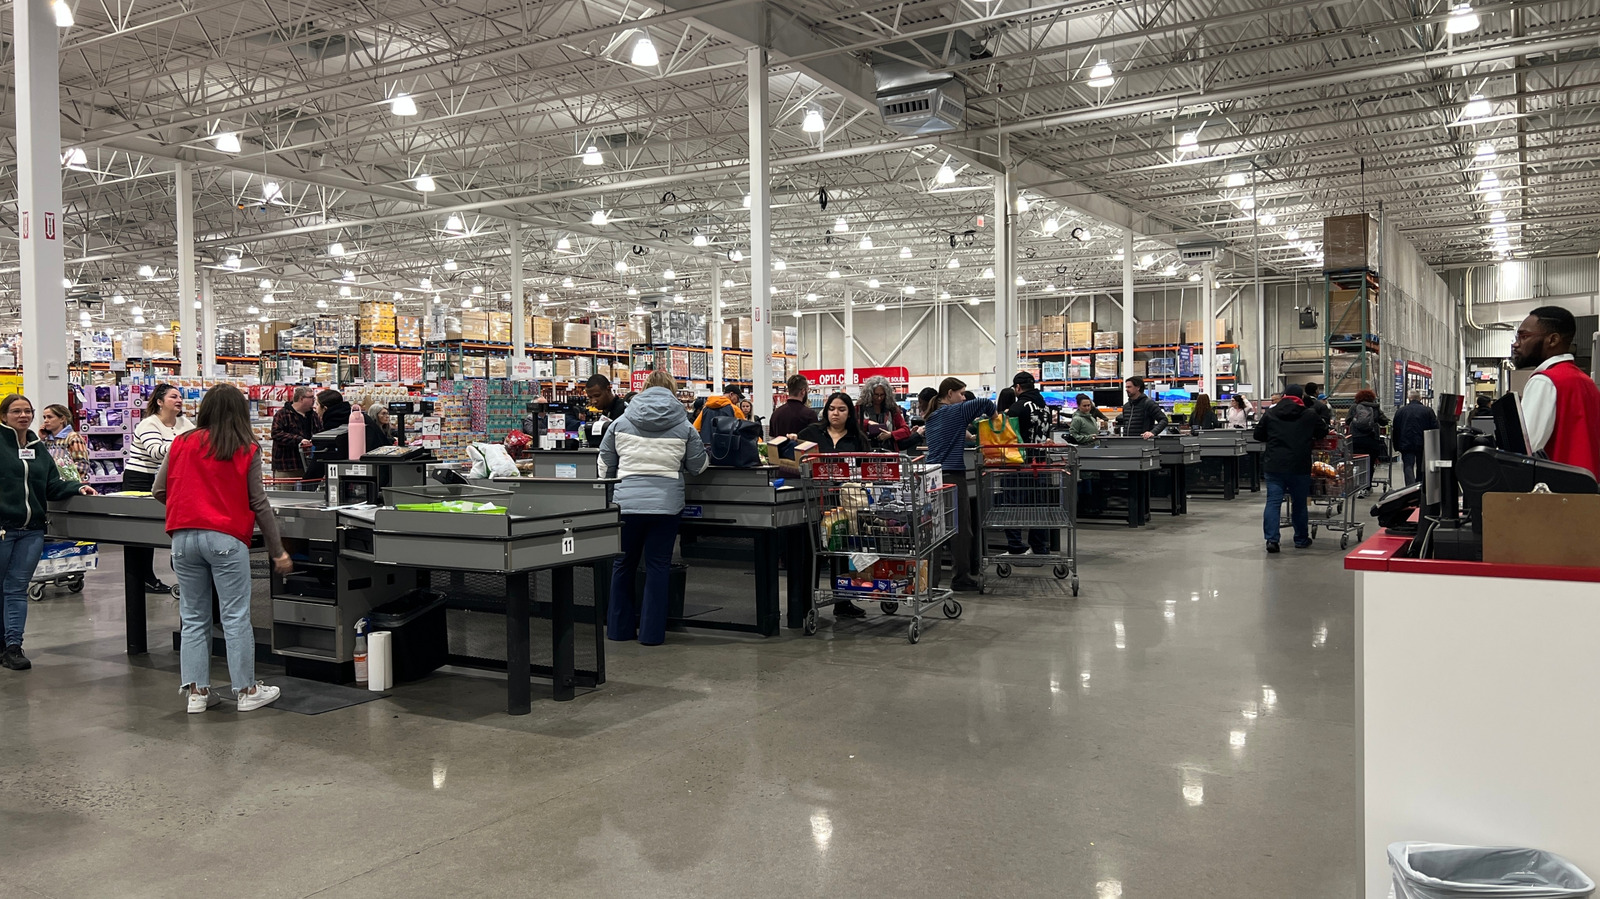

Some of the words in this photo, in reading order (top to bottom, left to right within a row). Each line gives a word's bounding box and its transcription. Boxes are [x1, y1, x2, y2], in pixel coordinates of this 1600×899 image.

[819, 373, 859, 384] OPTI-CB
[330, 466, 336, 477] 11
[564, 539, 572, 552] 11
